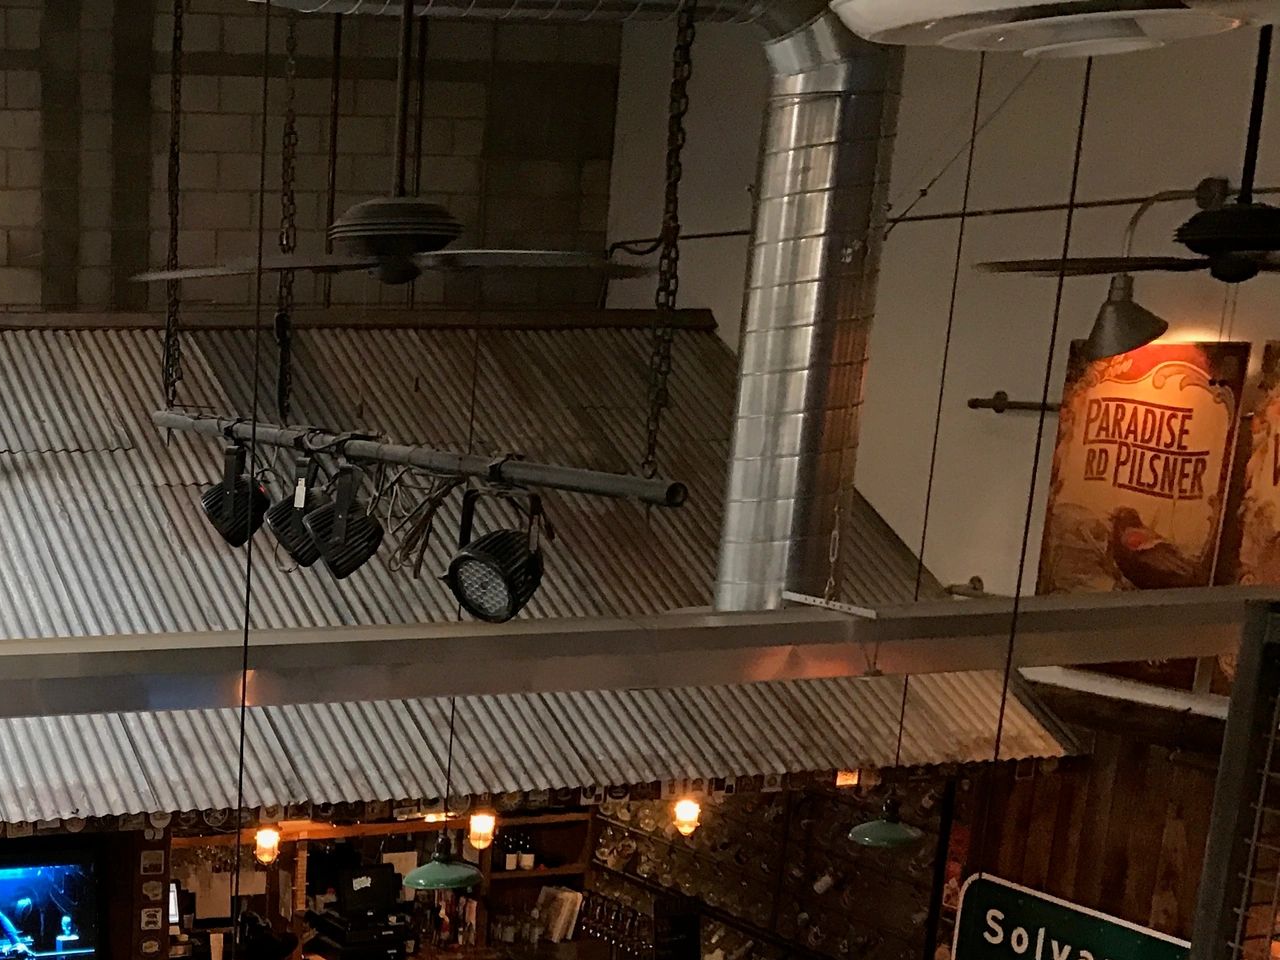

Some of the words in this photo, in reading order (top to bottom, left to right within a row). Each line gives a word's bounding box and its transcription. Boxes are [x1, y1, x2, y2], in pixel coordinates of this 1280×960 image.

[1083, 399, 1193, 450] PARADISE
[1084, 448, 1109, 477] RD
[1112, 440, 1207, 494] PILSNER
